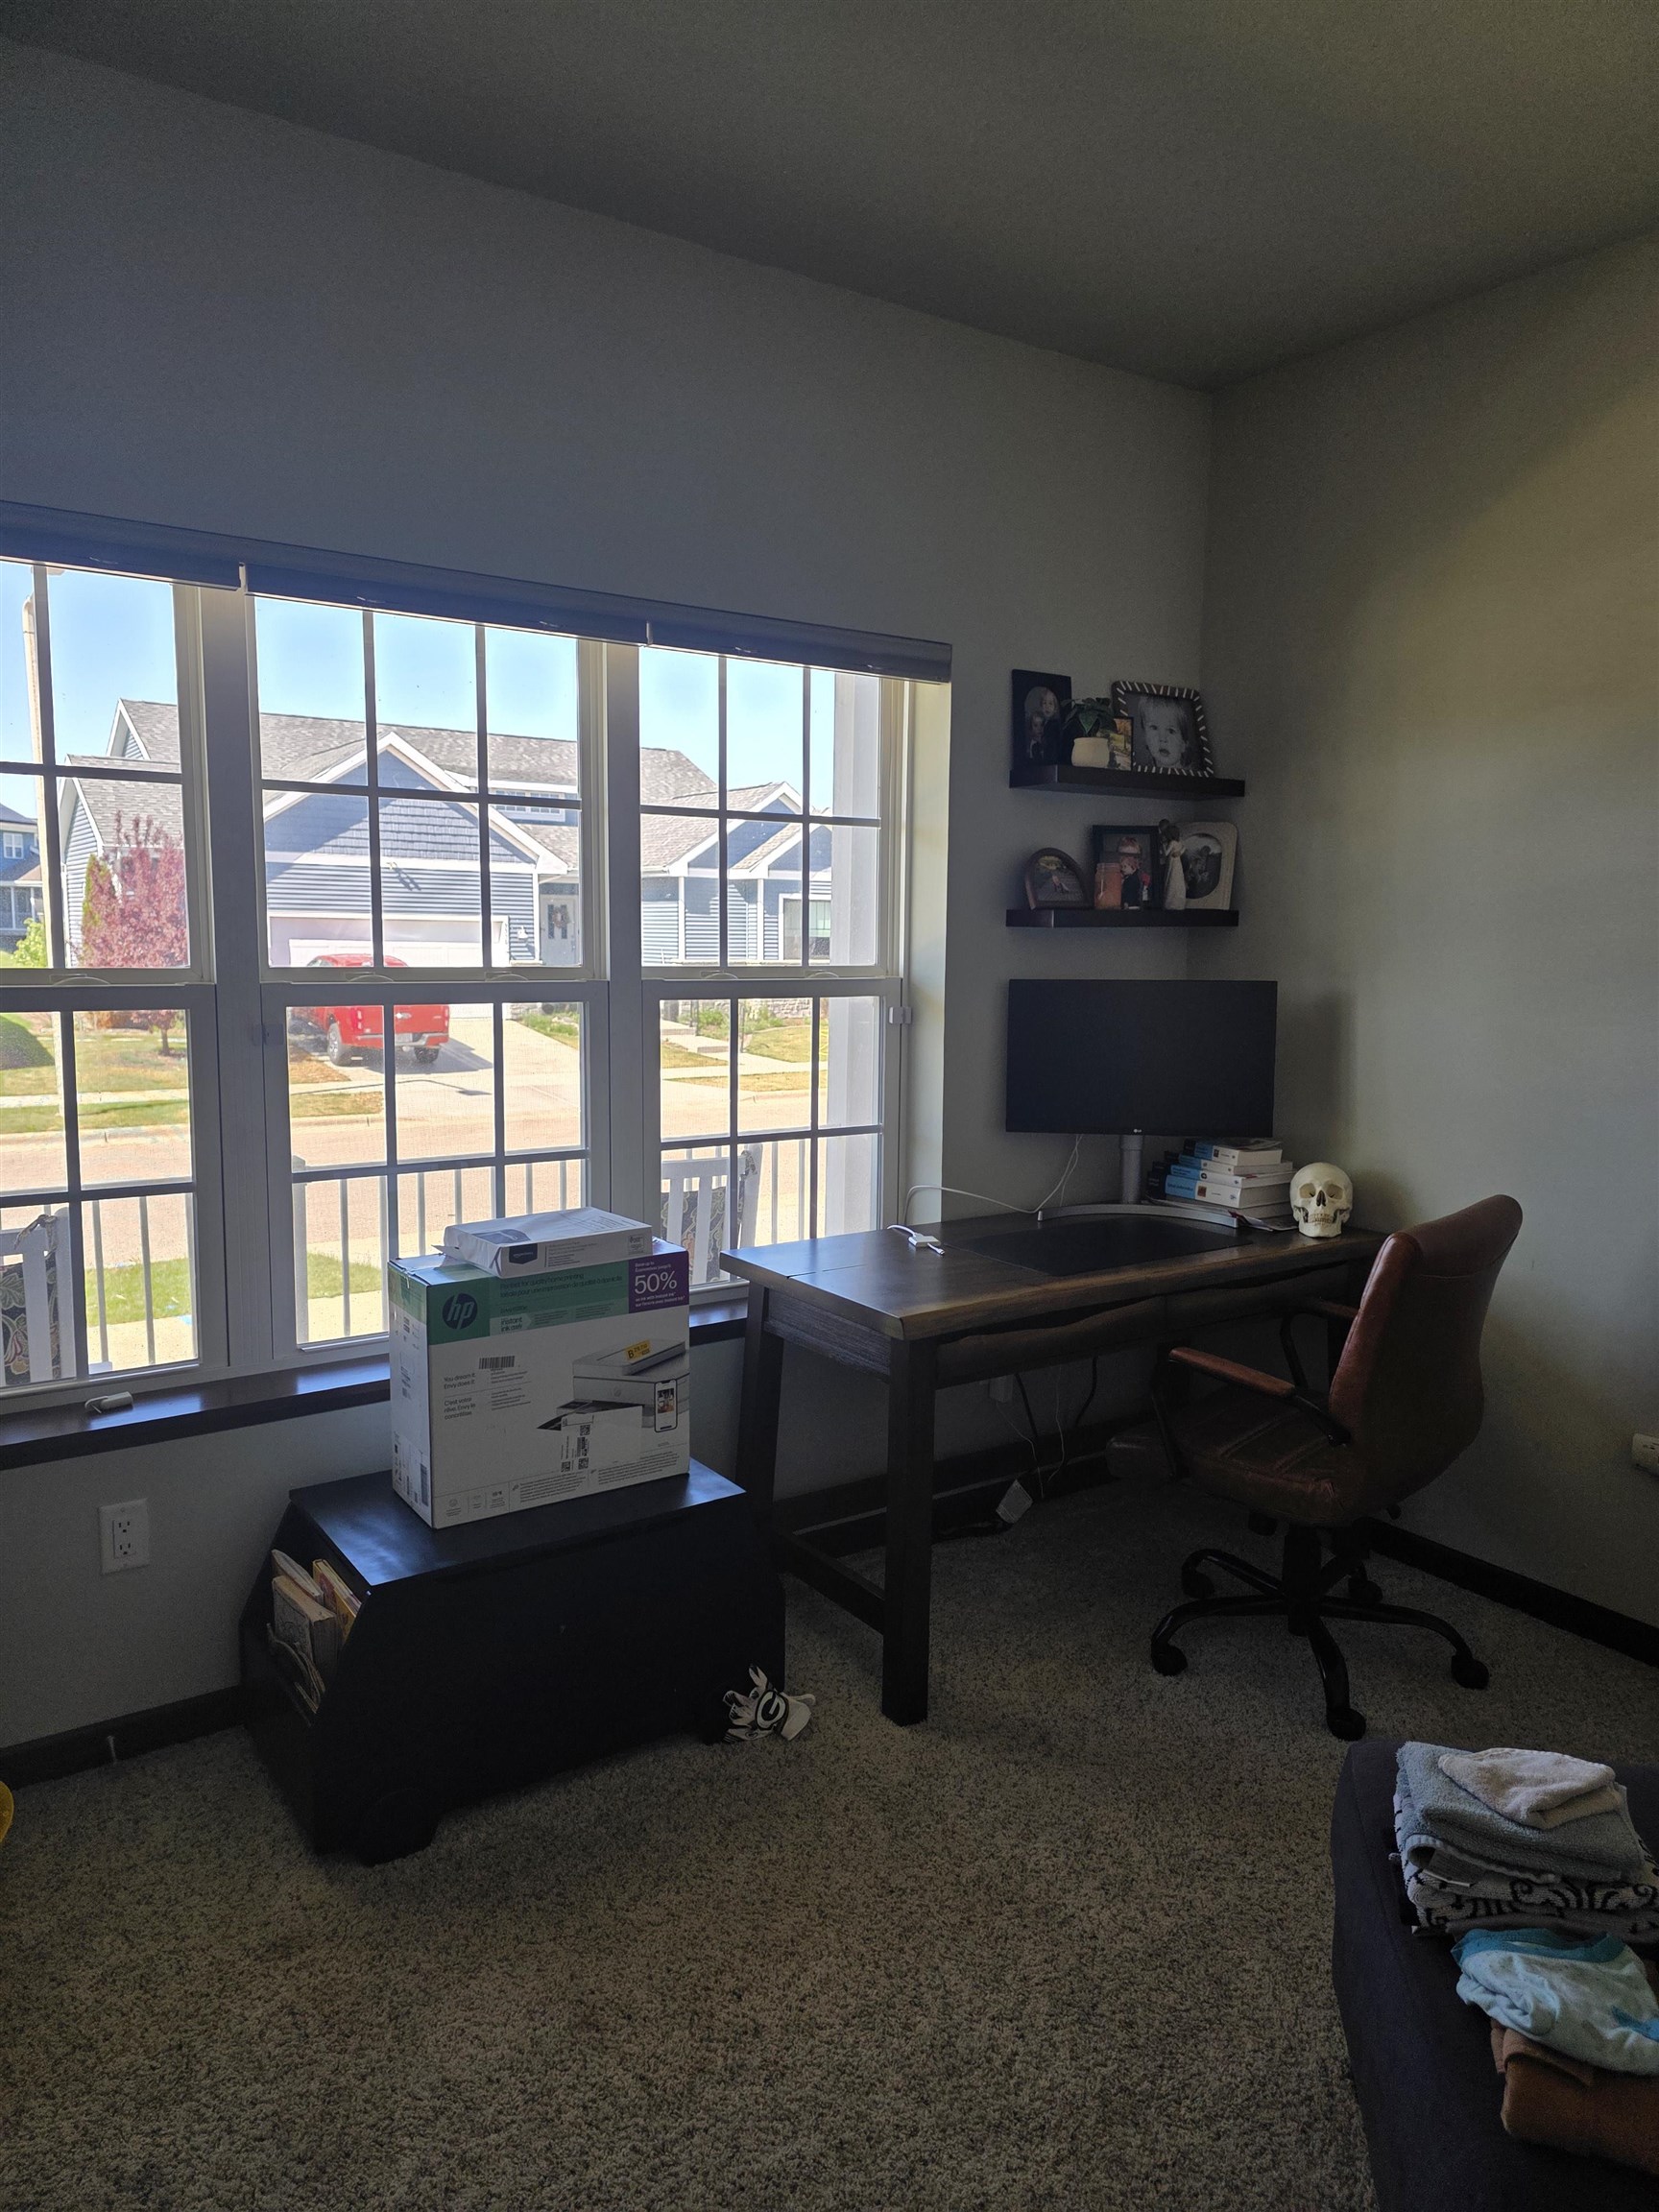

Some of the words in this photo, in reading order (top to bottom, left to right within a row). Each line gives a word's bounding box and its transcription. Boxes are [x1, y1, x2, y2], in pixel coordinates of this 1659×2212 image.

[635, 1270, 678, 1294] 50%
[445, 1293, 476, 1330] hp
[756, 1690, 788, 1730] G
